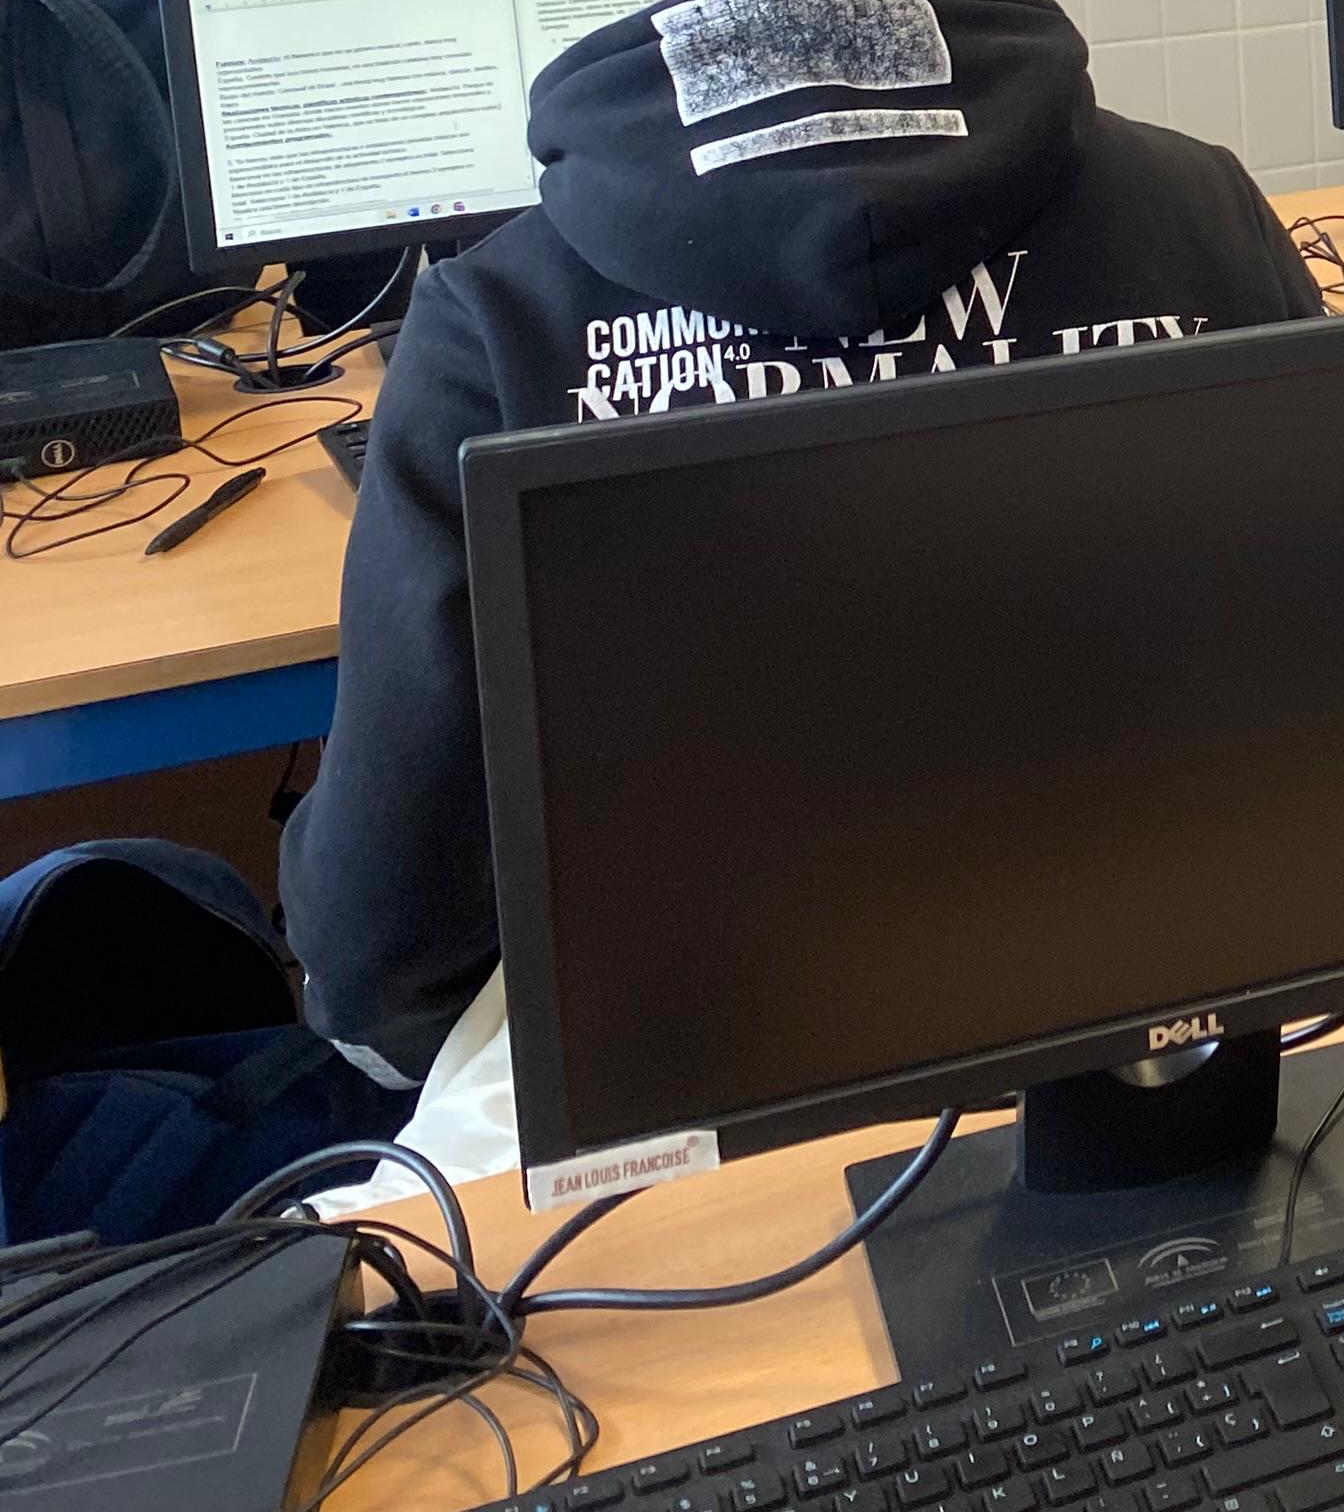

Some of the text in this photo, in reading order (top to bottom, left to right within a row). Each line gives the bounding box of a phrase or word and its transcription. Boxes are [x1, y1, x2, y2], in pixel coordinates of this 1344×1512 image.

[723, 342, 752, 364] 4.0
[1148, 1012, 1225, 1052] DELL
[552, 1148, 690, 1197] JEAN LOUIS FRANCOISE
[1081, 1415, 1095, 1429] P
[1023, 1433, 1038, 1447] O
[905, 1471, 920, 1484] U
[1052, 1467, 1065, 1481] L
[844, 1489, 857, 1502] Y
[992, 1488, 1006, 1499] K
